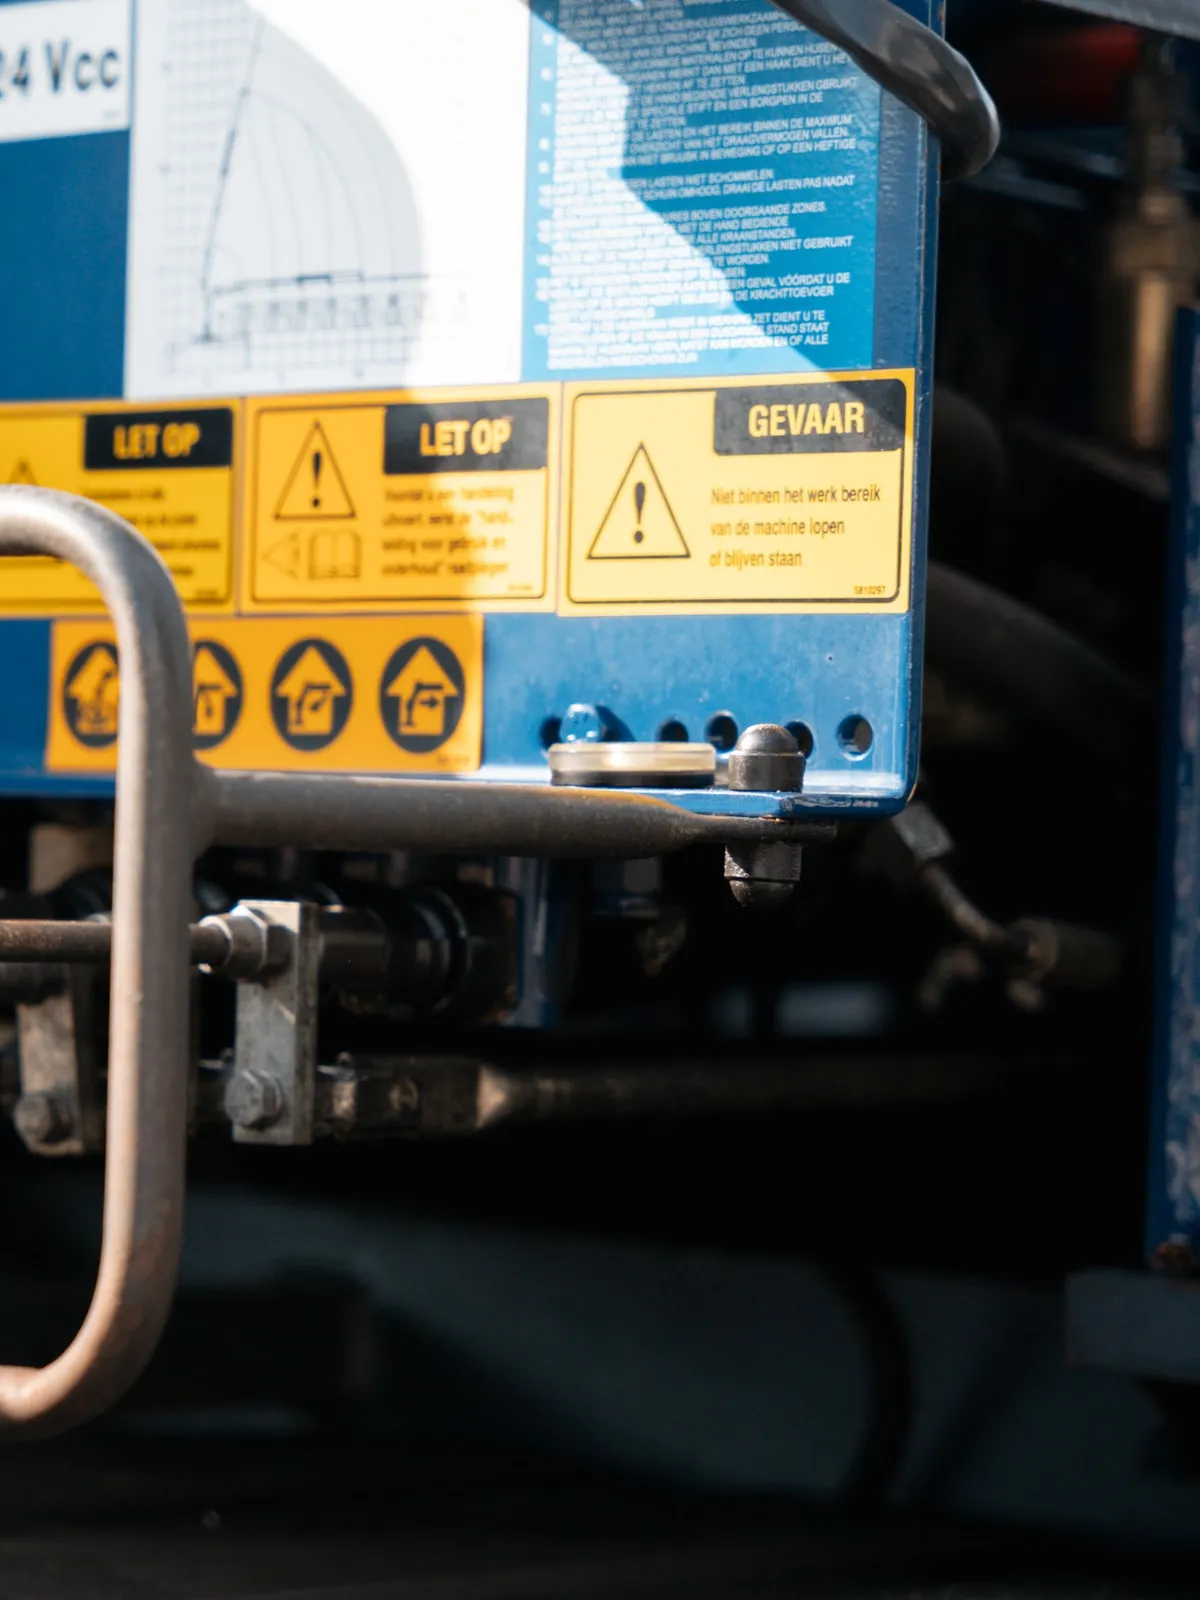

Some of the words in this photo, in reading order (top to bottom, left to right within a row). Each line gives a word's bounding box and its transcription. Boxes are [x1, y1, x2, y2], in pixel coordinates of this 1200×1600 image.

[765, 58, 791, 71] HAAK
[793, 55, 821, 69] DIENT
[810, 91, 823, 103] DE
[790, 116, 804, 129] DE
[806, 113, 853, 128] MAXIMUM
[723, 127, 810, 147] DRAAGVERMOGEN
[777, 141, 792, 155] OP
[793, 139, 812, 153] EEN
[814, 137, 856, 151] HEFTIGE
[752, 180, 765, 192] DE
[766, 177, 802, 191] LASTEN
[803, 176, 821, 189] PAS
[822, 173, 856, 188] NADAT
[723, 202, 790, 219] DOORGAANDE
[780, 237, 802, 251] NIET
[803, 234, 854, 249] GEBRUIKT
[747, 276, 776, 289] GEVAL
[826, 273, 835, 284] U
[836, 271, 851, 284] DE
[750, 285, 834, 300] KRACHTTOEVOER
[753, 312, 771, 325] ZET
[772, 310, 800, 323] DIENT
[802, 310, 811, 321] U
[812, 309, 825, 321] TE
[766, 323, 798, 336] STAND
[799, 320, 829, 334] STAAT
[789, 334, 803, 346] OF
[804, 332, 828, 345] ALLE
[748, 401, 865, 438] GEVAAR
[113, 424, 160, 459] LET
[162, 421, 200, 458] OP
[419, 420, 469, 457] LET
[471, 418, 512, 455] OP
[711, 489, 734, 505] Niet
[738, 489, 780, 504] binnen
[784, 488, 803, 503] het
[807, 486, 837, 502] werk
[841, 484, 881, 502] bereik
[710, 521, 731, 536] van
[735, 519, 750, 536] de
[753, 518, 806, 536] machine
[809, 517, 845, 539] lopen
[709, 550, 721, 567] of
[724, 551, 765, 571] blijven
[768, 551, 802, 567] staan
